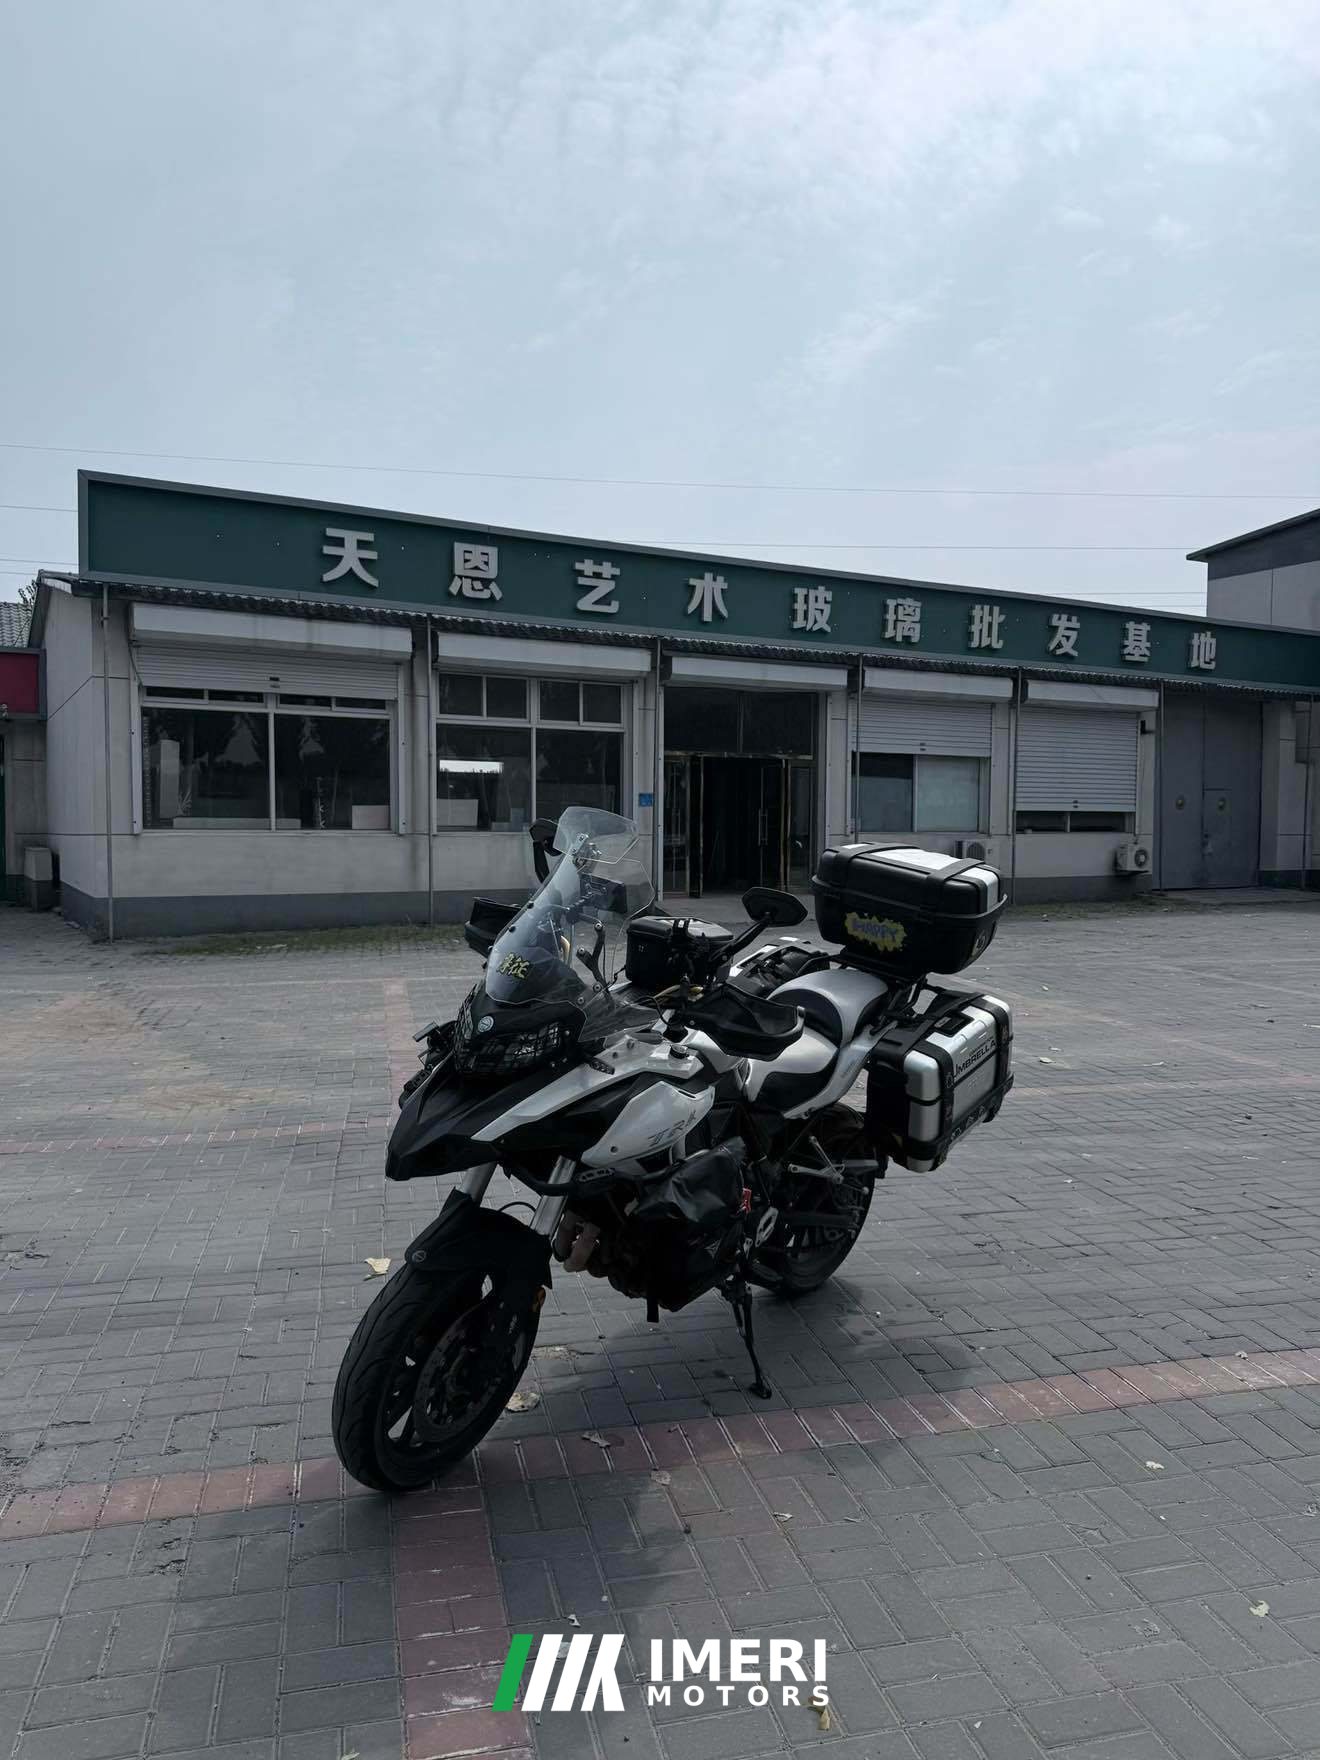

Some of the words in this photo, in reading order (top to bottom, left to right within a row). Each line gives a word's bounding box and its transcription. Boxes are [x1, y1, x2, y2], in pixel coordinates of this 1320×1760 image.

[321, 527, 1217, 671] 天恩艺术玻璃批发基地
[953, 1039, 997, 1077] UMBRELLA
